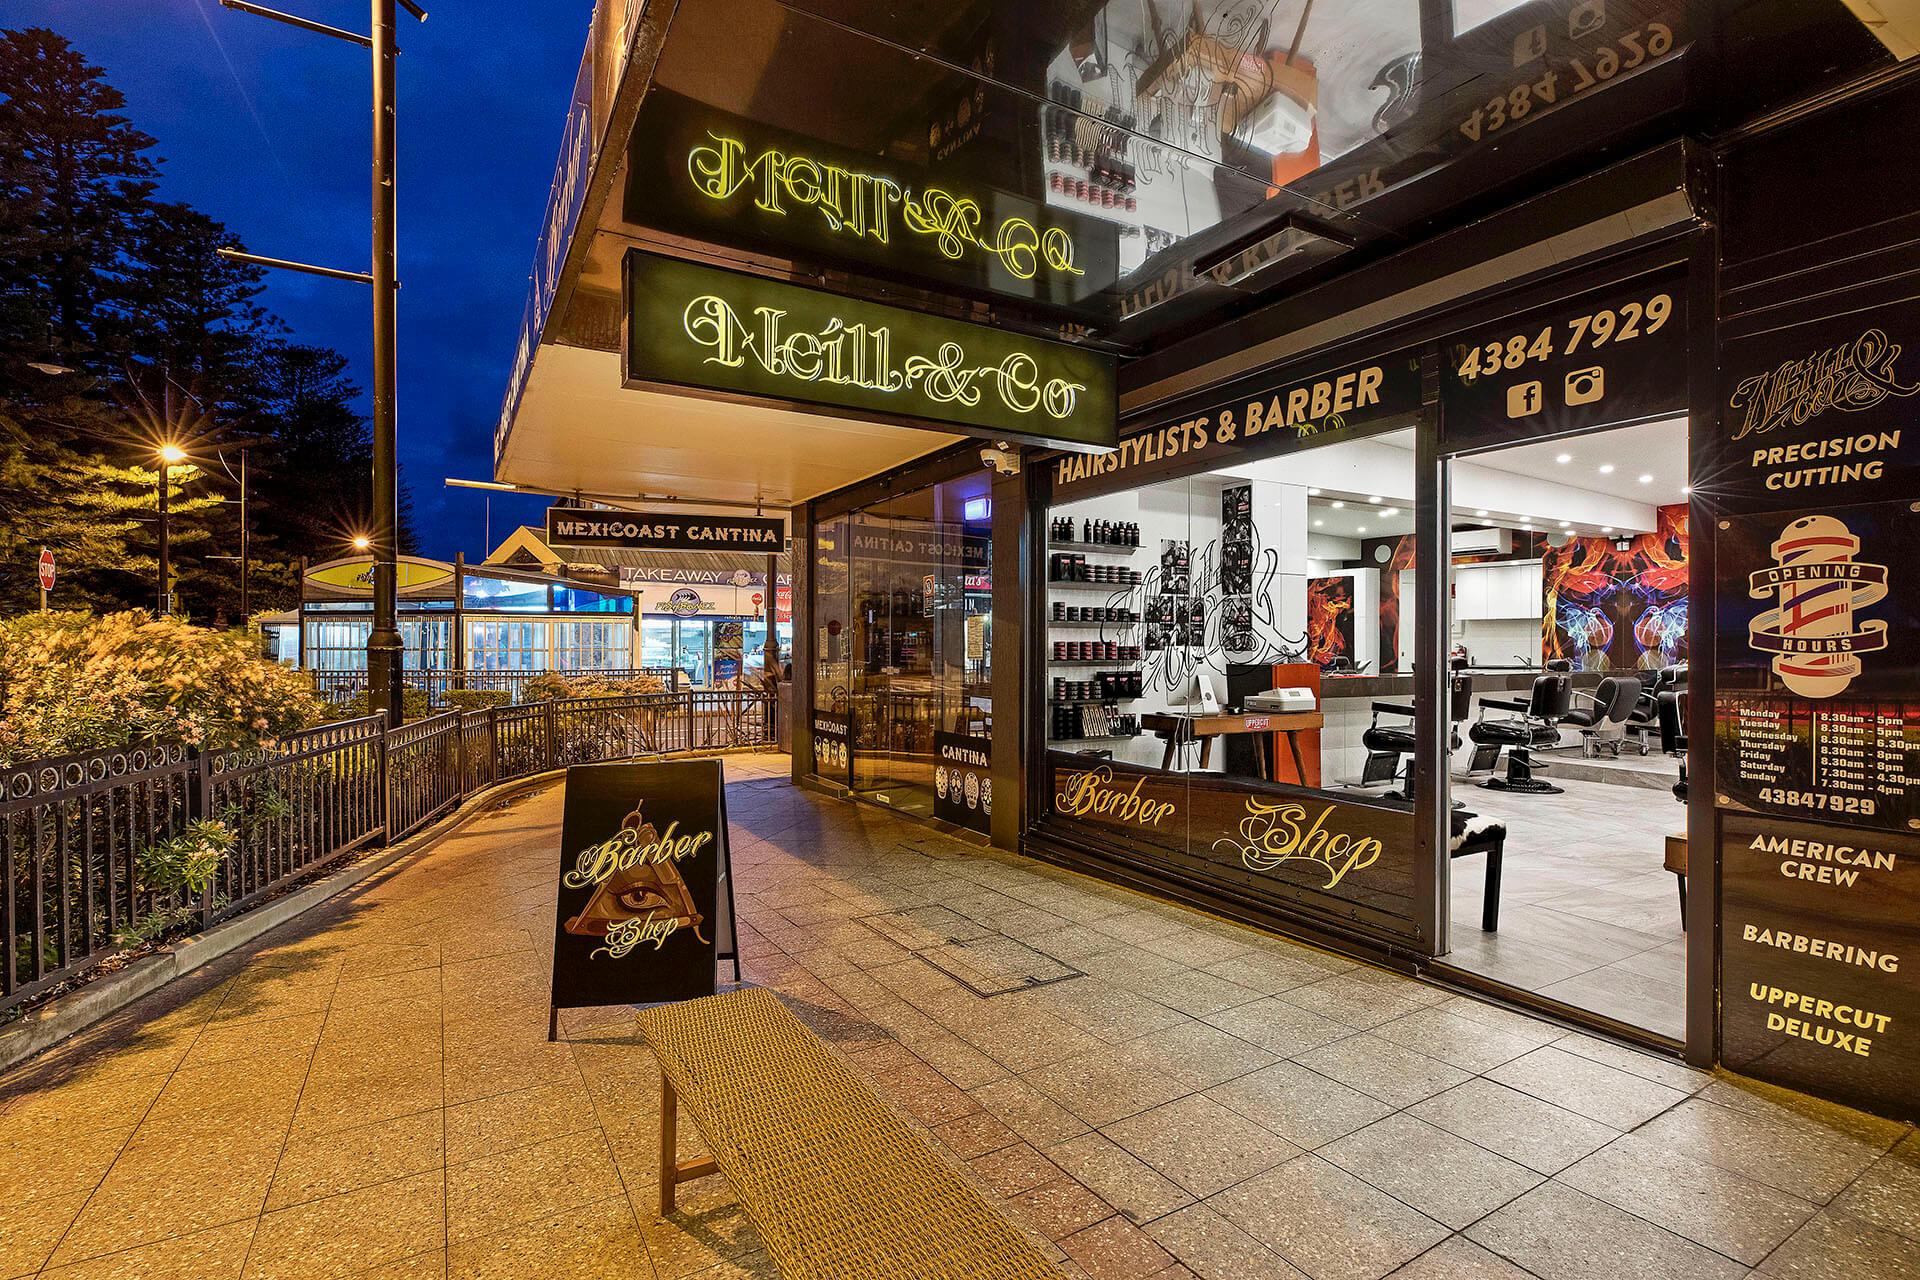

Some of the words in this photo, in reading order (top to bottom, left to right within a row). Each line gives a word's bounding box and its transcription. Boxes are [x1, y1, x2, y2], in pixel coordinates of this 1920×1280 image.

[1458, 326, 1553, 380] 4384
[1564, 293, 1673, 356] 7929
[904, 341, 982, 406] &
[980, 352, 1087, 419] Co
[1058, 417, 1210, 485] HAIRSTYLISTS
[1216, 409, 1237, 443] &
[1245, 366, 1384, 437] BARBER
[1752, 430, 1902, 468] PRECISION
[1765, 461, 1885, 491] CUTTING
[556, 521, 680, 540] MEXICOAST
[686, 526, 778, 543] CANTINA
[41, 562, 55, 578] STOP
[624, 567, 723, 584] TAKEAWAY
[1768, 565, 1862, 583] OPENING
[1783, 638, 1852, 653] HOURS
[1740, 708, 1780, 720] Monday
[1820, 712, 1865, 724] 8.30am
[1877, 715, 1904, 726] 5pm
[1740, 718, 1780, 730] Tuesday
[1820, 723, 1865, 735] 8.30am
[1877, 726, 1904, 738] 5pm
[1740, 729, 1798, 743] Wednesday
[1820, 735, 1865, 746] 8.30am
[1877, 739, 1920, 751] 6.30pm
[1740, 739, 1786, 753] Thursday
[1820, 746, 1865, 758] 8.30am
[1877, 750, 1904, 761] 8pm
[942, 744, 988, 767] CANTINA
[1740, 750, 1771, 762] Friday
[1820, 757, 1865, 769] 8.30am
[1877, 761, 1904, 772] 8pm
[1740, 760, 1786, 774] Saturday
[1820, 767, 1865, 780] 7.30am
[1877, 773, 1920, 786] 4.30pm
[1740, 770, 1777, 783] Sunday
[1820, 778, 1865, 791] 7.30am
[1877, 784, 1904, 795] 4pm
[1758, 787, 1877, 816] 43847929
[1055, 764, 1176, 827] Barber
[1211, 794, 1383, 890] Shop
[563, 821, 714, 890] Barber
[1749, 834, 1897, 872] AMERICAN
[1780, 860, 1860, 888] CREW
[589, 910, 680, 961] Shop
[1742, 924, 1900, 974] BARBERING
[1749, 982, 1893, 1034] UPPERCUT
[1766, 1012, 1873, 1057] DELUXE
